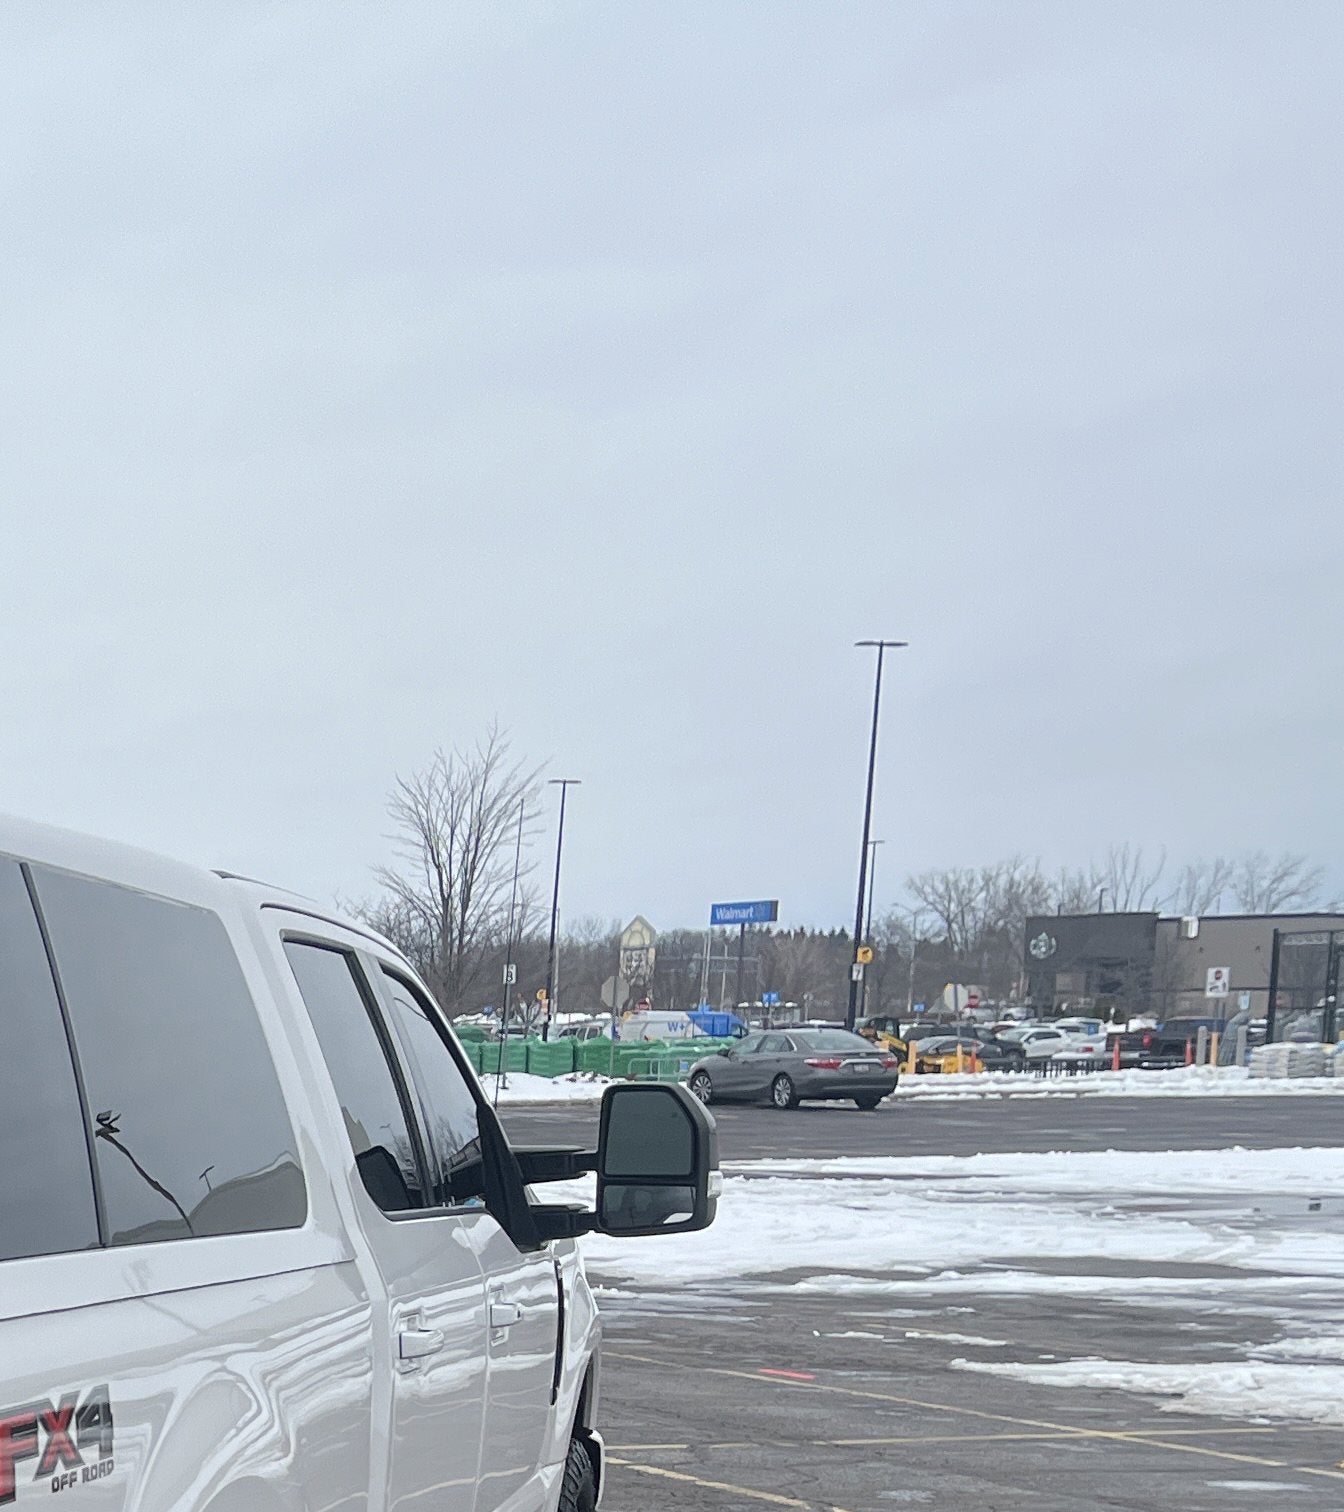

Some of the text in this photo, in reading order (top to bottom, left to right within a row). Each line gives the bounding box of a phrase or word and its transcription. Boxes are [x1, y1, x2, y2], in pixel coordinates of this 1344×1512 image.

[715, 905, 754, 920] Walmart
[51, 1458, 114, 1494] OFF ROAD
